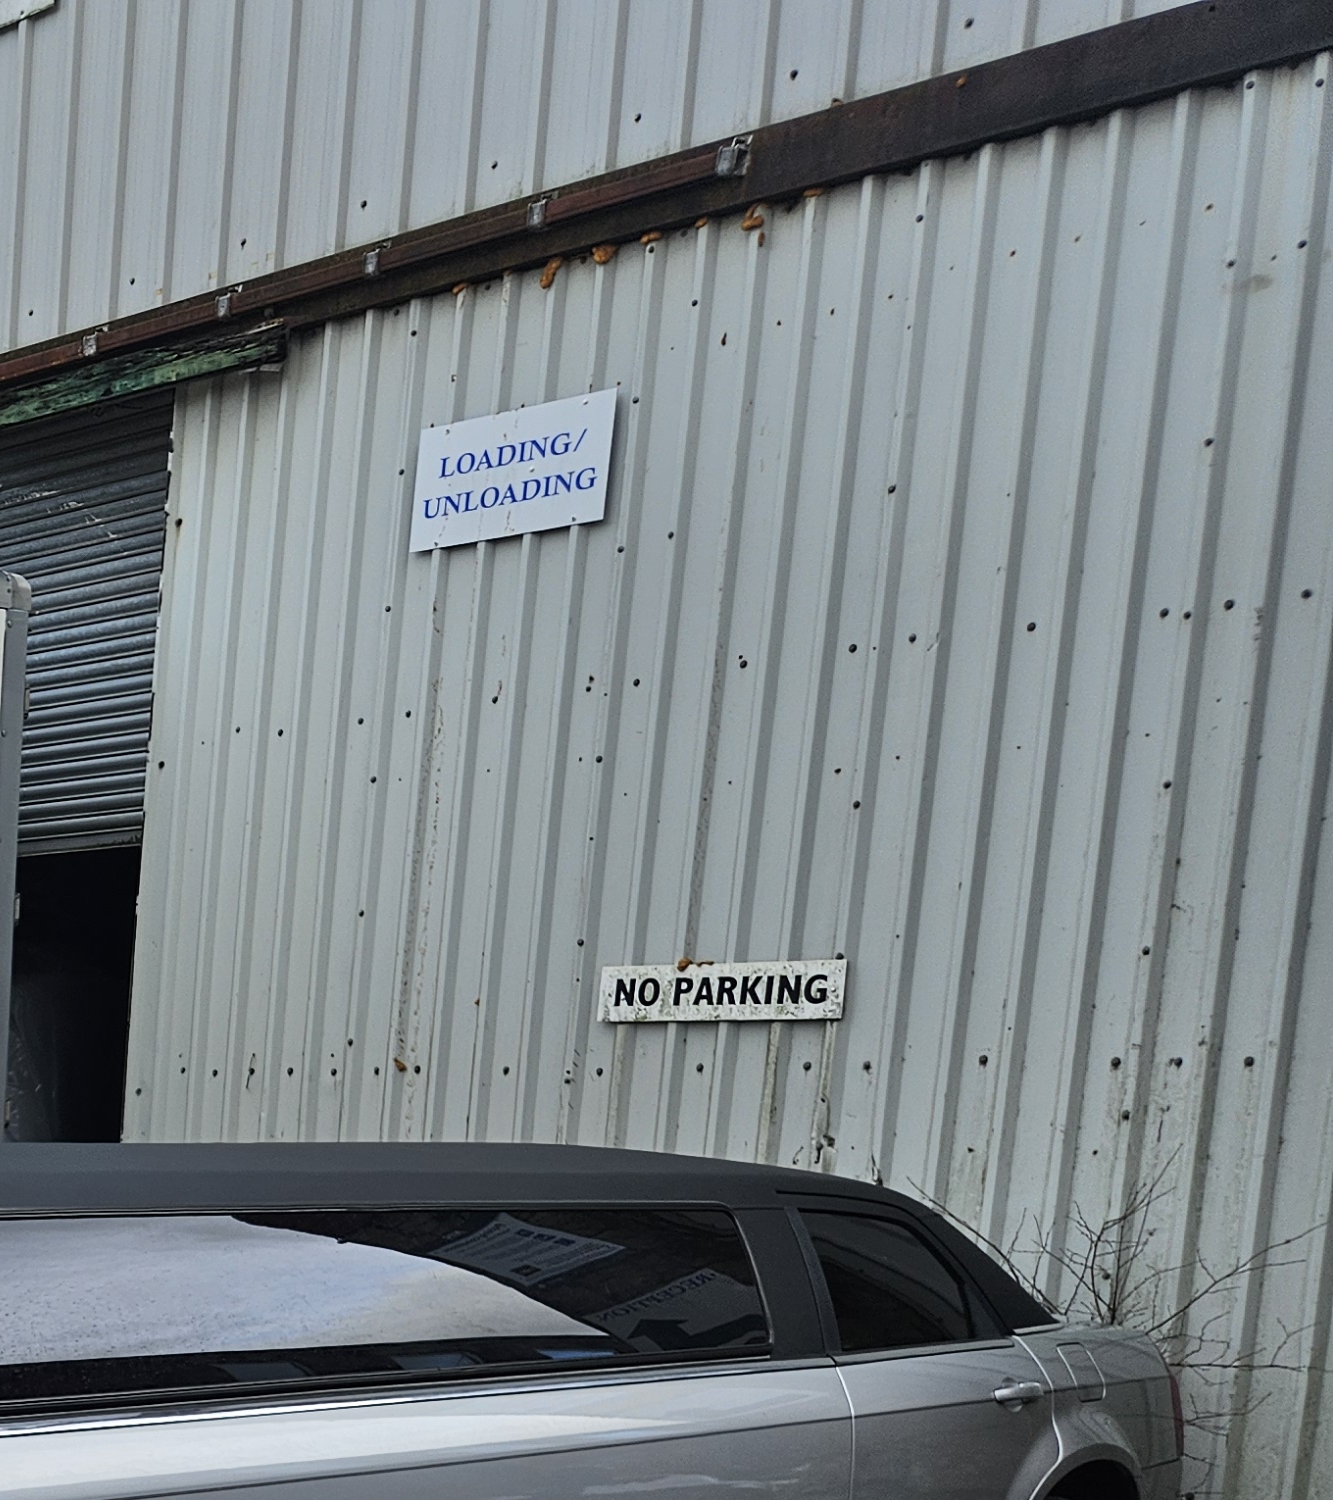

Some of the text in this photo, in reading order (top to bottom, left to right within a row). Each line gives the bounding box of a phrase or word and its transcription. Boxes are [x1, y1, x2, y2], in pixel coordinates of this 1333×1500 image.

[438, 428, 588, 479] LOADING/
[423, 467, 598, 519] UNLOADING
[613, 974, 829, 1007] NO PARKING
